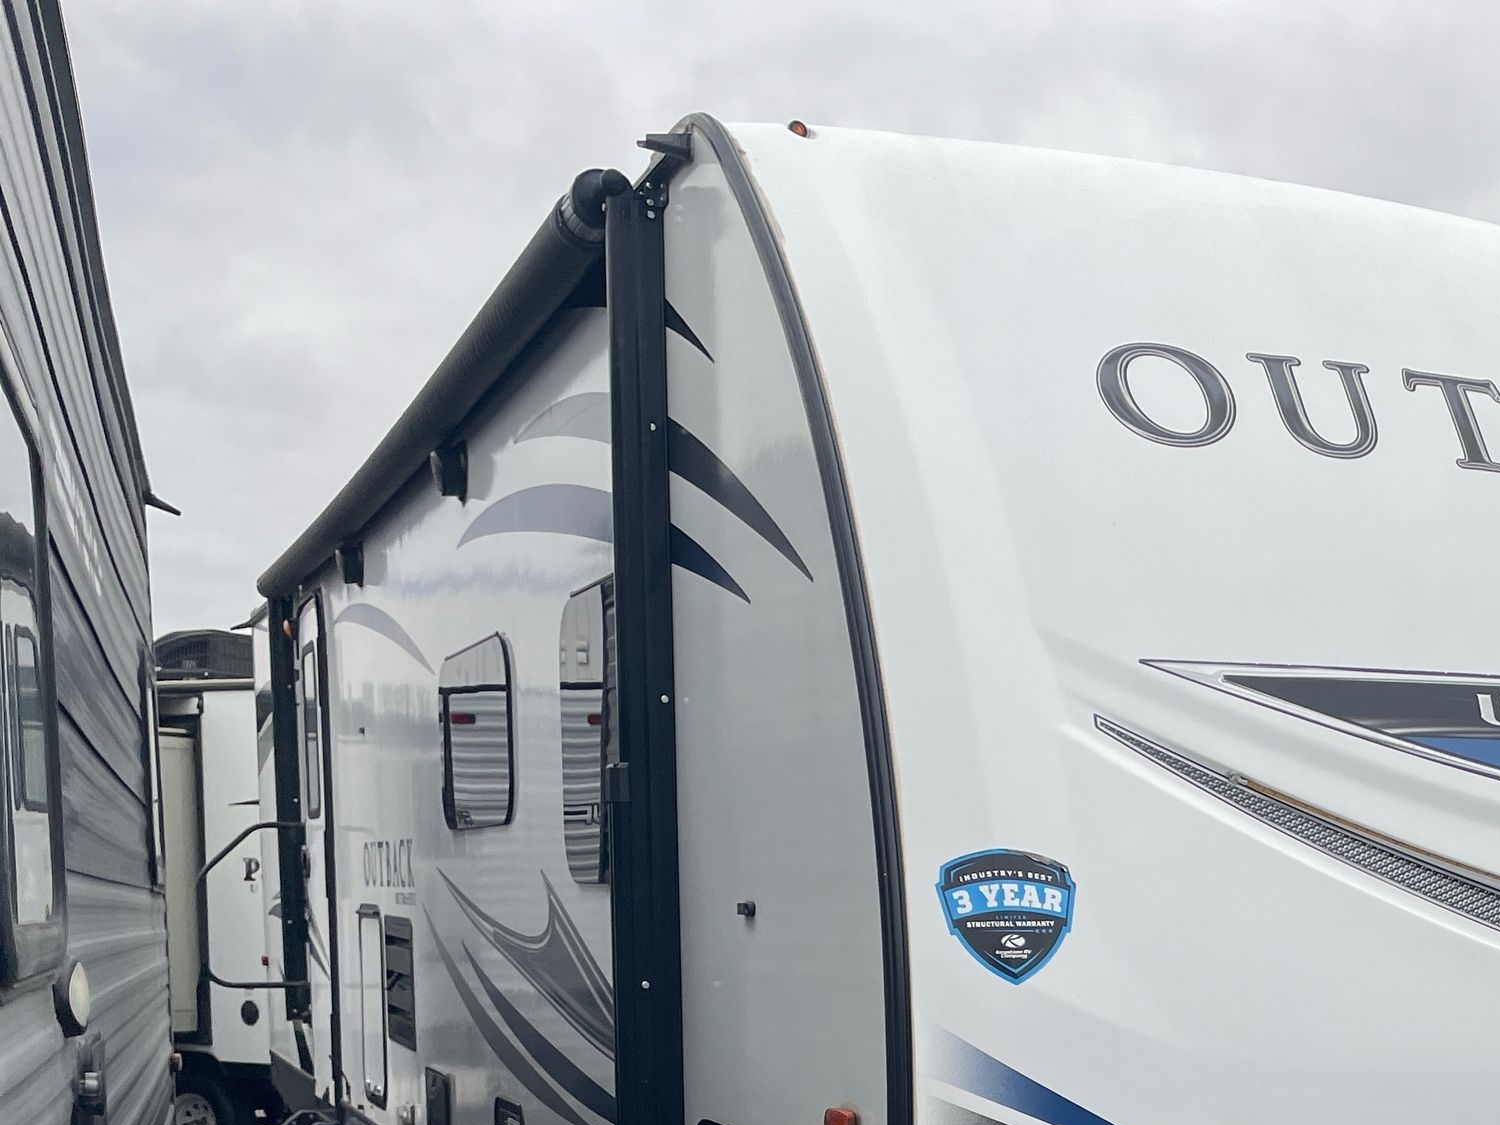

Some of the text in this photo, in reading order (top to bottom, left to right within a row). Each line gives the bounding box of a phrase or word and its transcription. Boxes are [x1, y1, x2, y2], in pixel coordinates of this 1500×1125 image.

[363, 838, 416, 888] OUTBACK
[959, 870, 1053, 882] INDUSTRY'S BEST
[952, 883, 1062, 915] 3 YEAR
